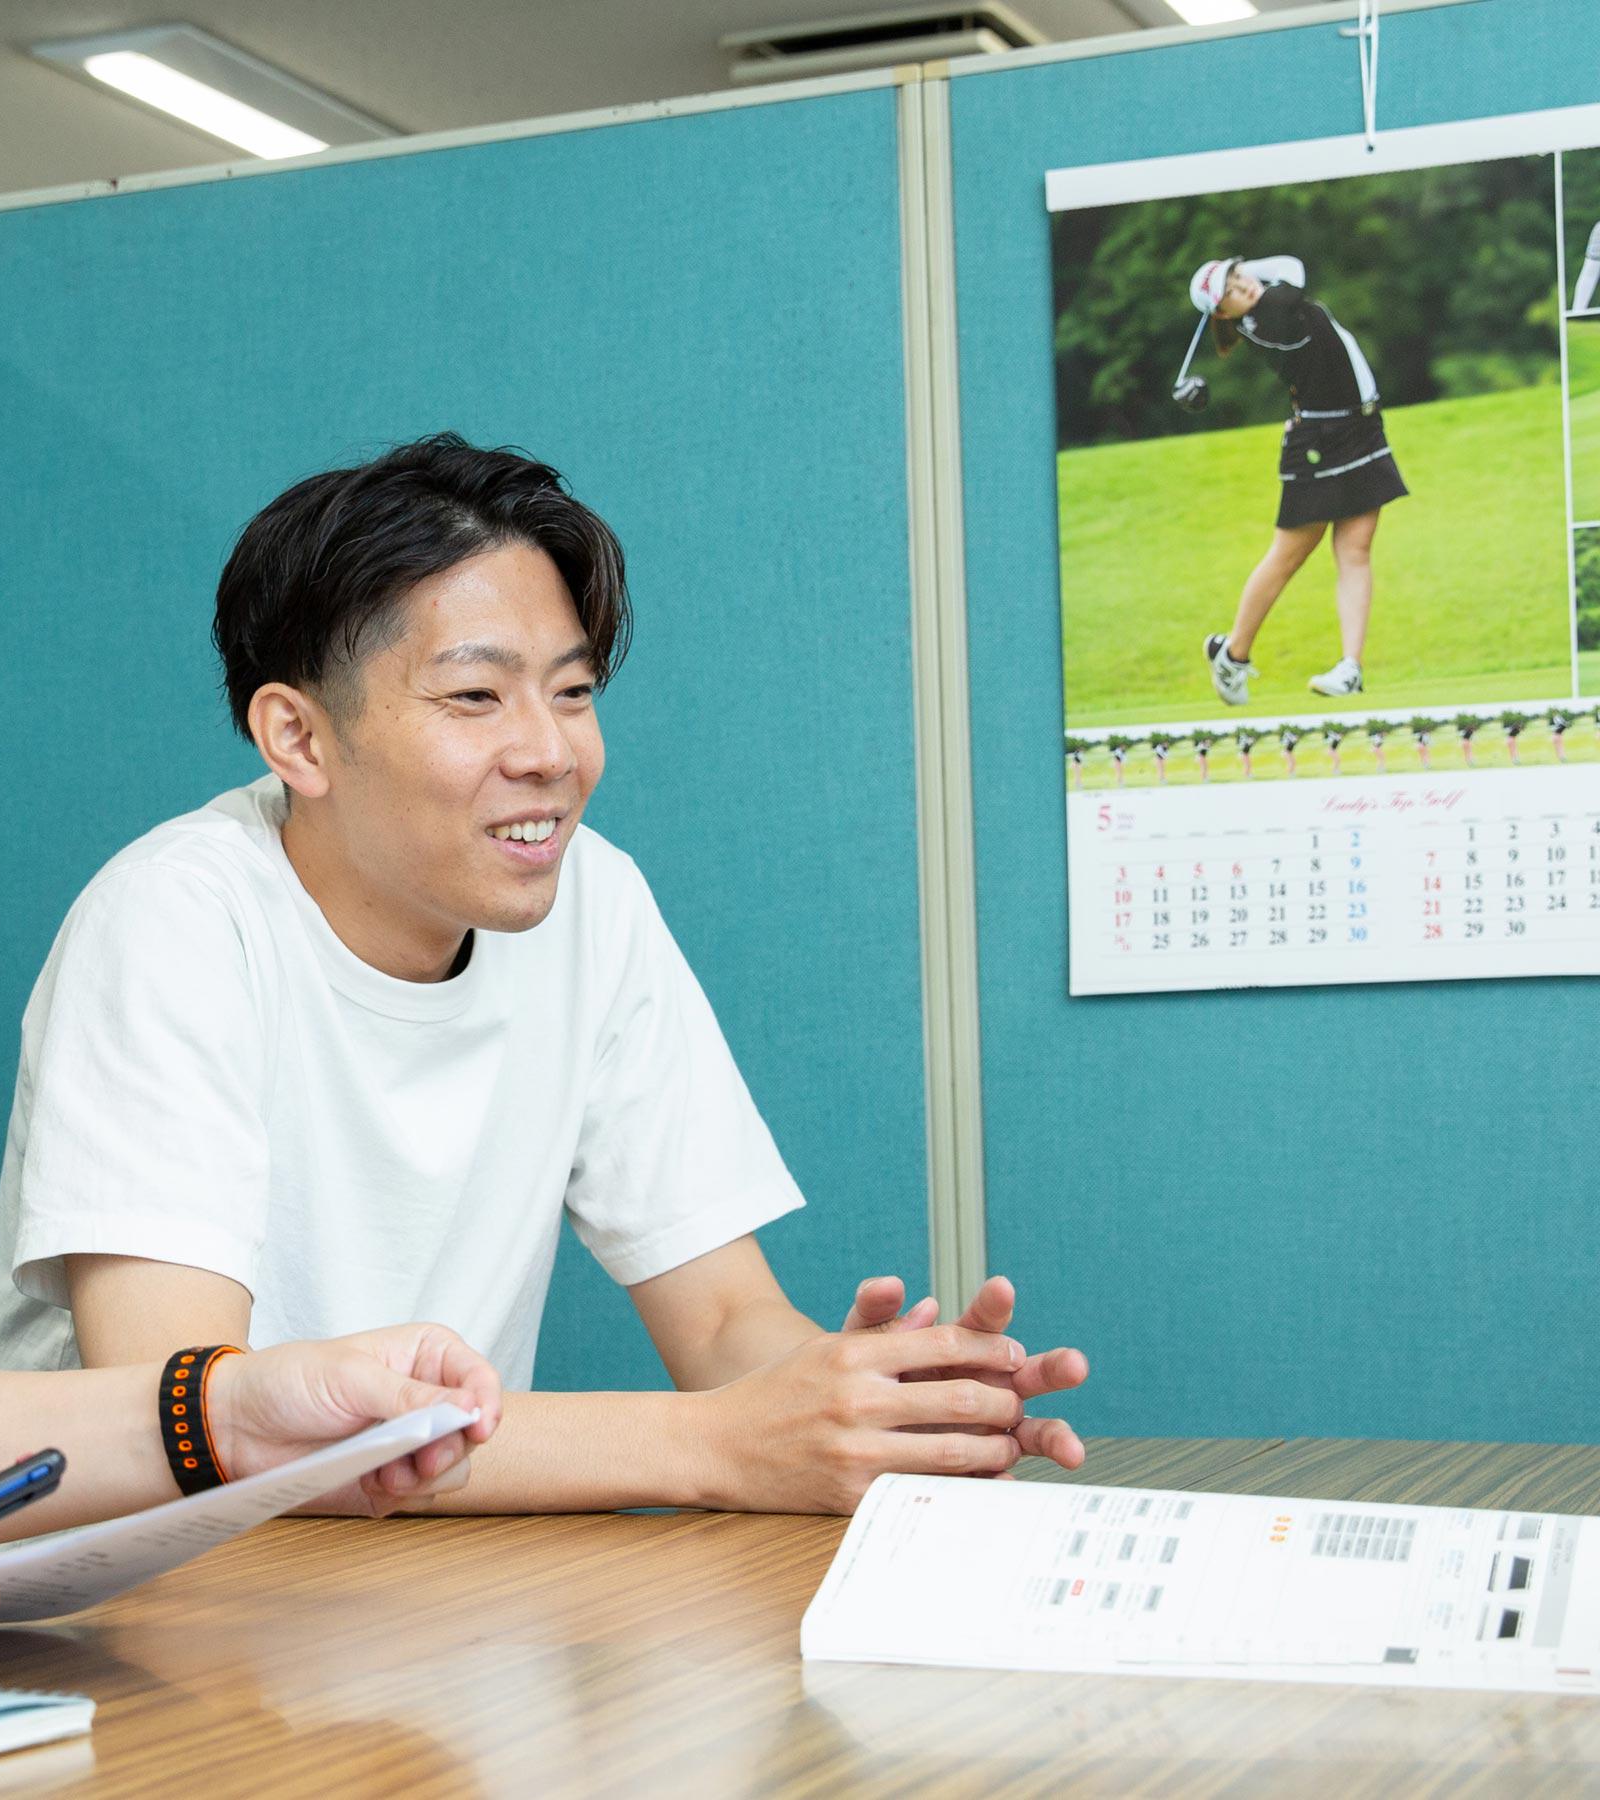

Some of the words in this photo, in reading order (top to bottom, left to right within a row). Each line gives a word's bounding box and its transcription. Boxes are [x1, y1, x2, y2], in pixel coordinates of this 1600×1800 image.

[1098, 804, 1111, 831] 5
[1351, 832, 1360, 848] 2
[1509, 824, 1518, 840] 2
[1550, 822, 1560, 838] 3
[1426, 851, 1436, 866] 7
[1467, 850, 1477, 865] 8
[1508, 849, 1519, 864] 9
[1547, 847, 1566, 862] 10
[1155, 865, 1165, 880] 4
[1193, 862, 1203, 879] 5
[1232, 862, 1242, 879] 6
[1272, 858, 1280, 874] 7
[1311, 857, 1321, 872] 8
[1351, 856, 1361, 871] 9
[1424, 876, 1441, 891] 14
[1465, 874, 1482, 890] 15
[1506, 873, 1525, 888] 16
[1548, 870, 1565, 887] 17
[1115, 890, 1132, 905] 10
[1153, 888, 1168, 902] 11
[1191, 886, 1208, 901] 12
[1230, 885, 1247, 900] 13
[1269, 883, 1286, 898] 14
[1309, 880, 1326, 896] 15
[1349, 880, 1367, 894] 16
[1115, 912, 1132, 927] 17
[1153, 911, 1170, 926] 18
[1191, 910, 1209, 924] 19
[1230, 908, 1248, 923] 20
[1269, 906, 1285, 922] 21
[1308, 904, 1326, 920] 22
[1348, 903, 1367, 919] 23
[1423, 899, 1440, 916] 21
[1464, 897, 1483, 914] 22
[1506, 896, 1525, 912] 23
[1547, 894, 1566, 911] 24
[1153, 934, 1169, 950] 25
[1191, 932, 1209, 948] 26
[1230, 930, 1247, 946] 27
[1269, 929, 1287, 945] 28
[1308, 928, 1327, 944] 29
[1348, 927, 1367, 943] 30
[1423, 923, 1442, 939] 28
[1464, 921, 1484, 938] 29
[1505, 920, 1526, 937] 30
